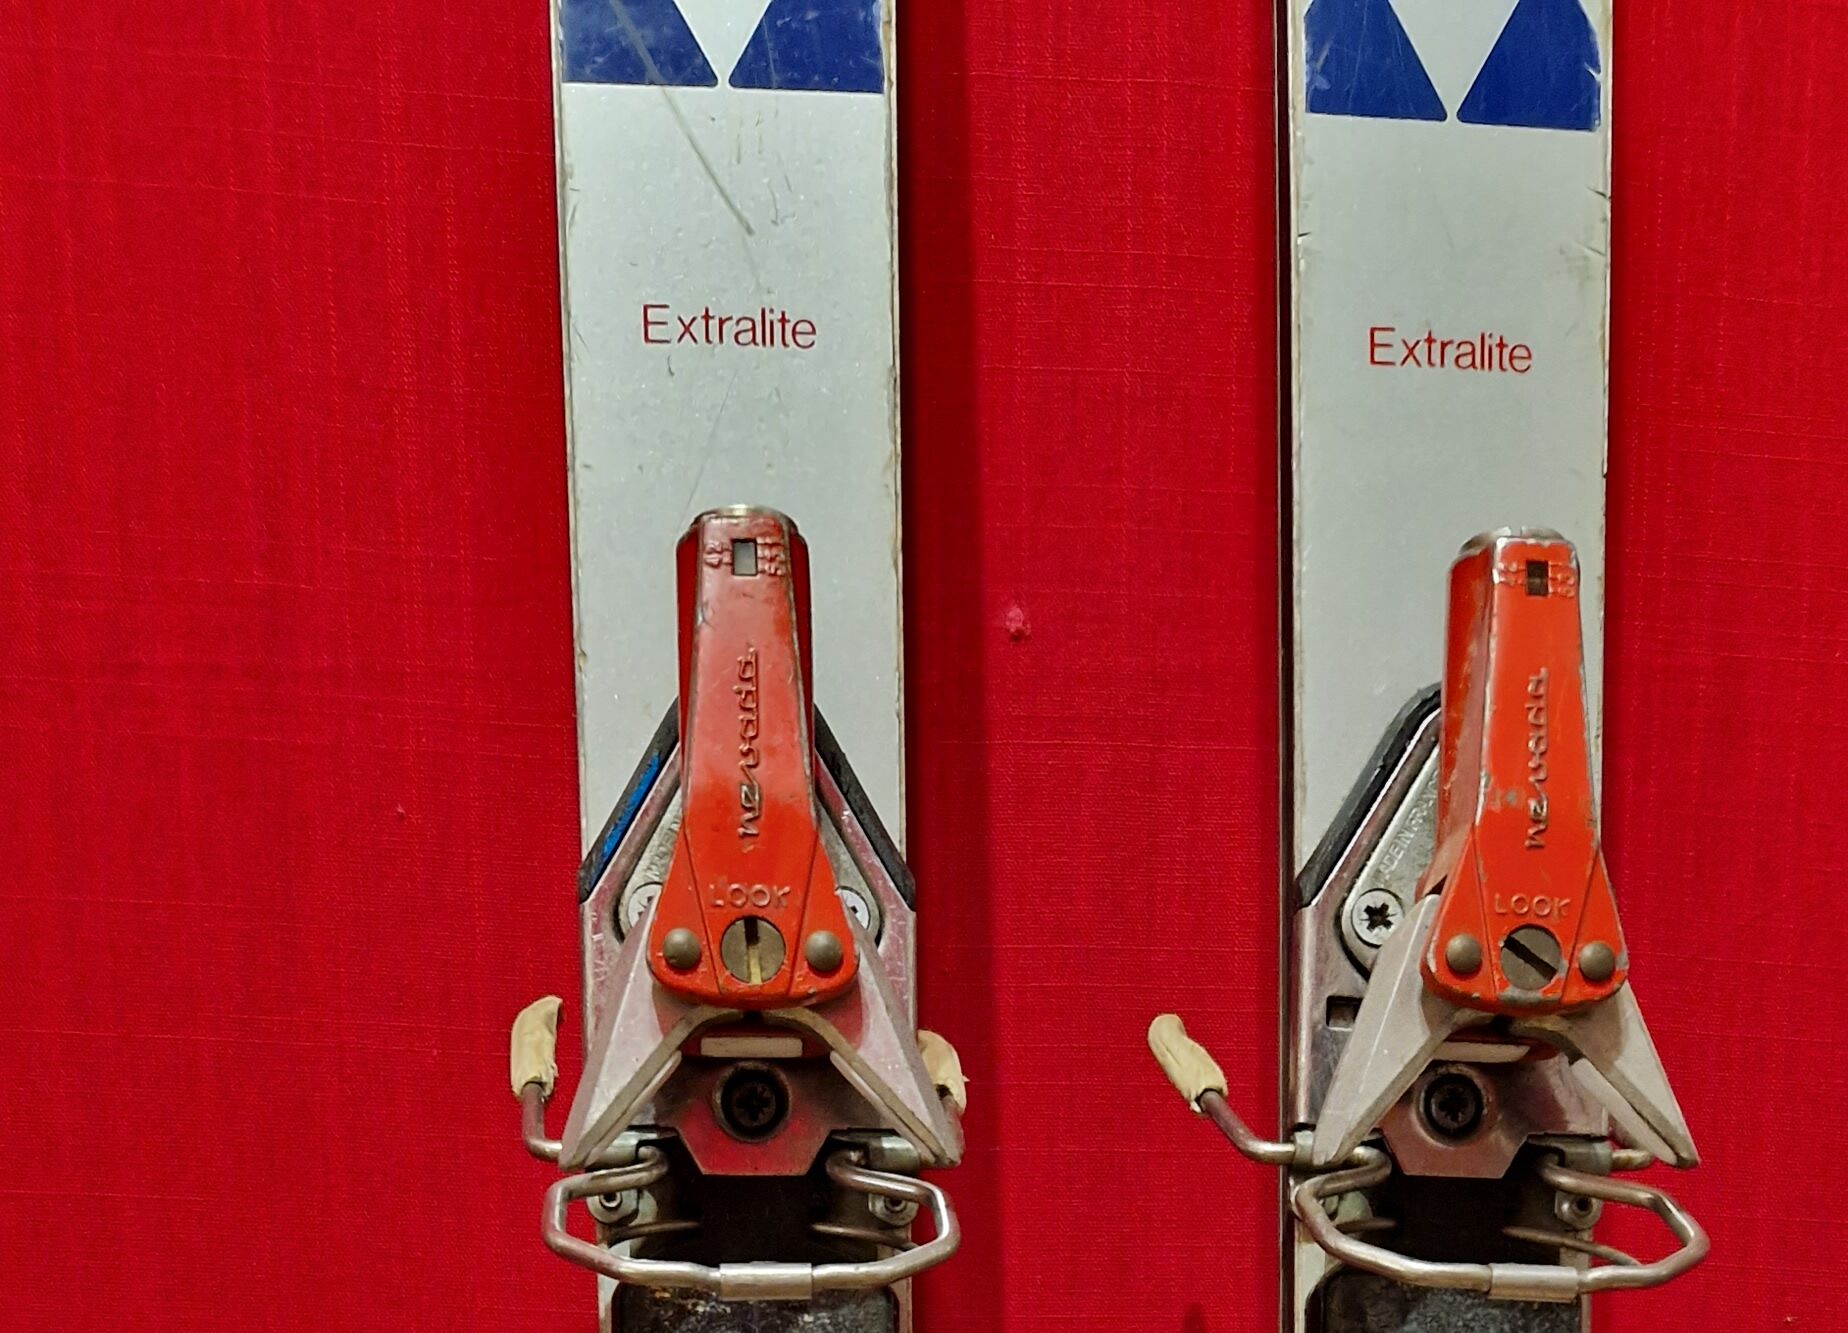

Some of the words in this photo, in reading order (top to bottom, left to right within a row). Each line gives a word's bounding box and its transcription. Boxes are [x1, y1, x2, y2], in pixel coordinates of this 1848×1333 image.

[642, 303, 817, 350] Extralite
[1367, 326, 1533, 375] Extralite
[707, 881, 791, 907] LOOK
[1493, 890, 1571, 918] LOOK
